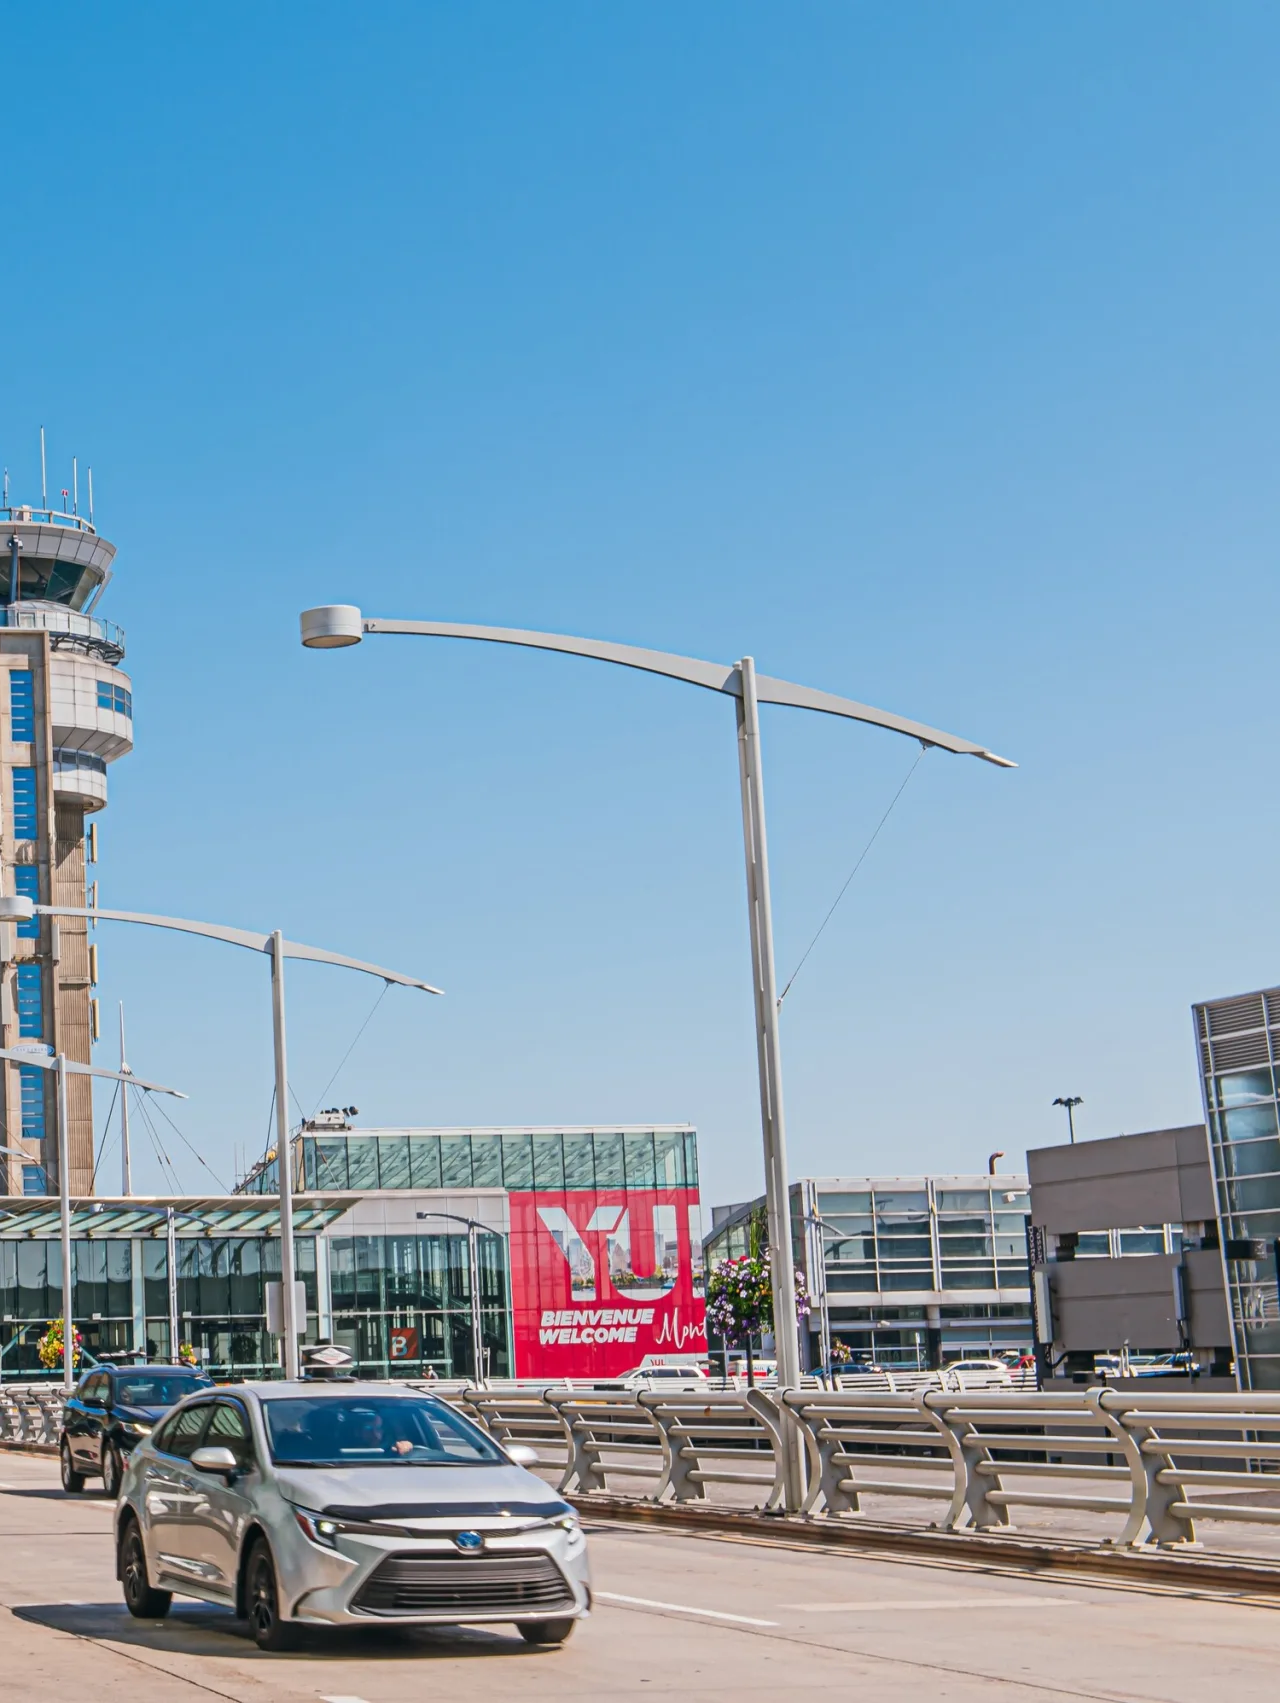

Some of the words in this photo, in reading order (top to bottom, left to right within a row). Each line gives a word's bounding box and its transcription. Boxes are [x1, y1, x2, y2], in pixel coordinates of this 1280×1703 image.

[541, 1309, 655, 1326] BIENVENUE
[539, 1327, 638, 1344] WELCOME
[391, 1336, 408, 1357] B
